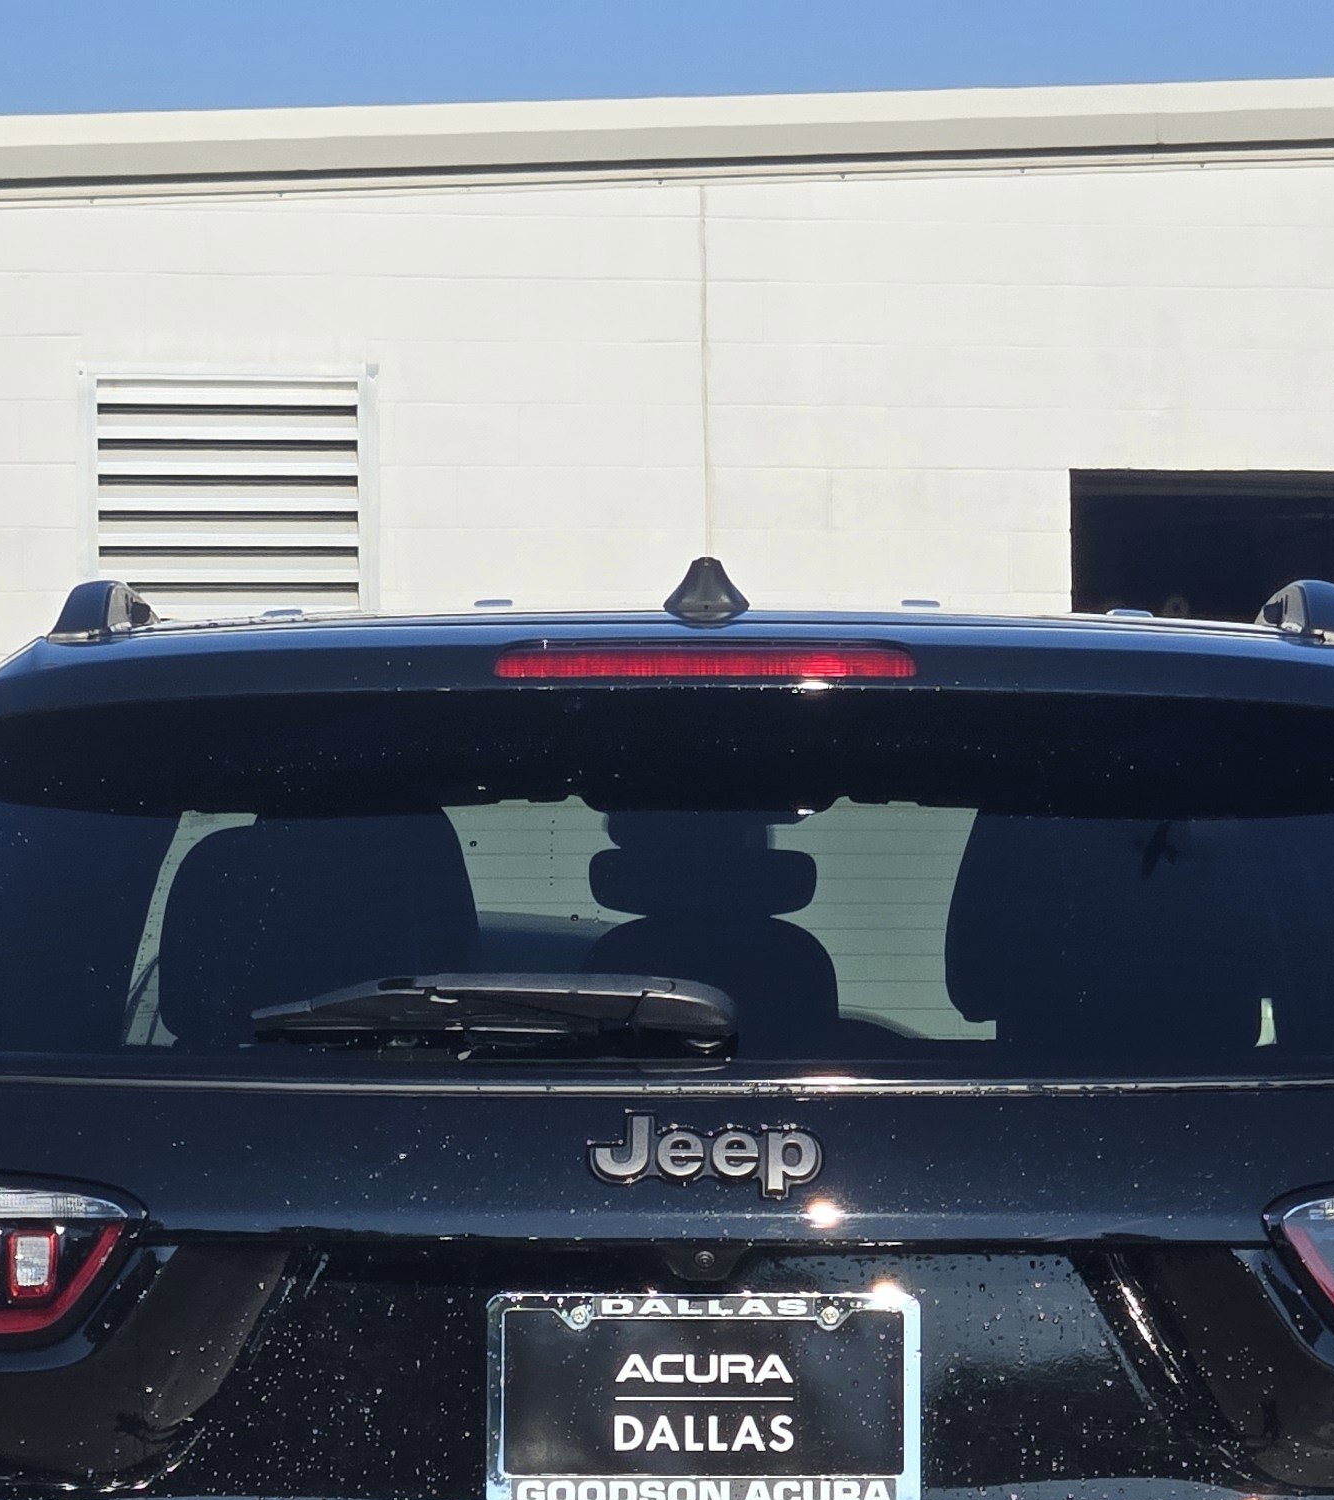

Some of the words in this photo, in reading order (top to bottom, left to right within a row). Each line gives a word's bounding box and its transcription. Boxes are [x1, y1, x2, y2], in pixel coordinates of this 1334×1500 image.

[591, 1113, 822, 1196] Jeep
[601, 1299, 808, 1317] DALLAS
[615, 1354, 794, 1383] ACURA
[614, 1415, 794, 1452] DALLAS
